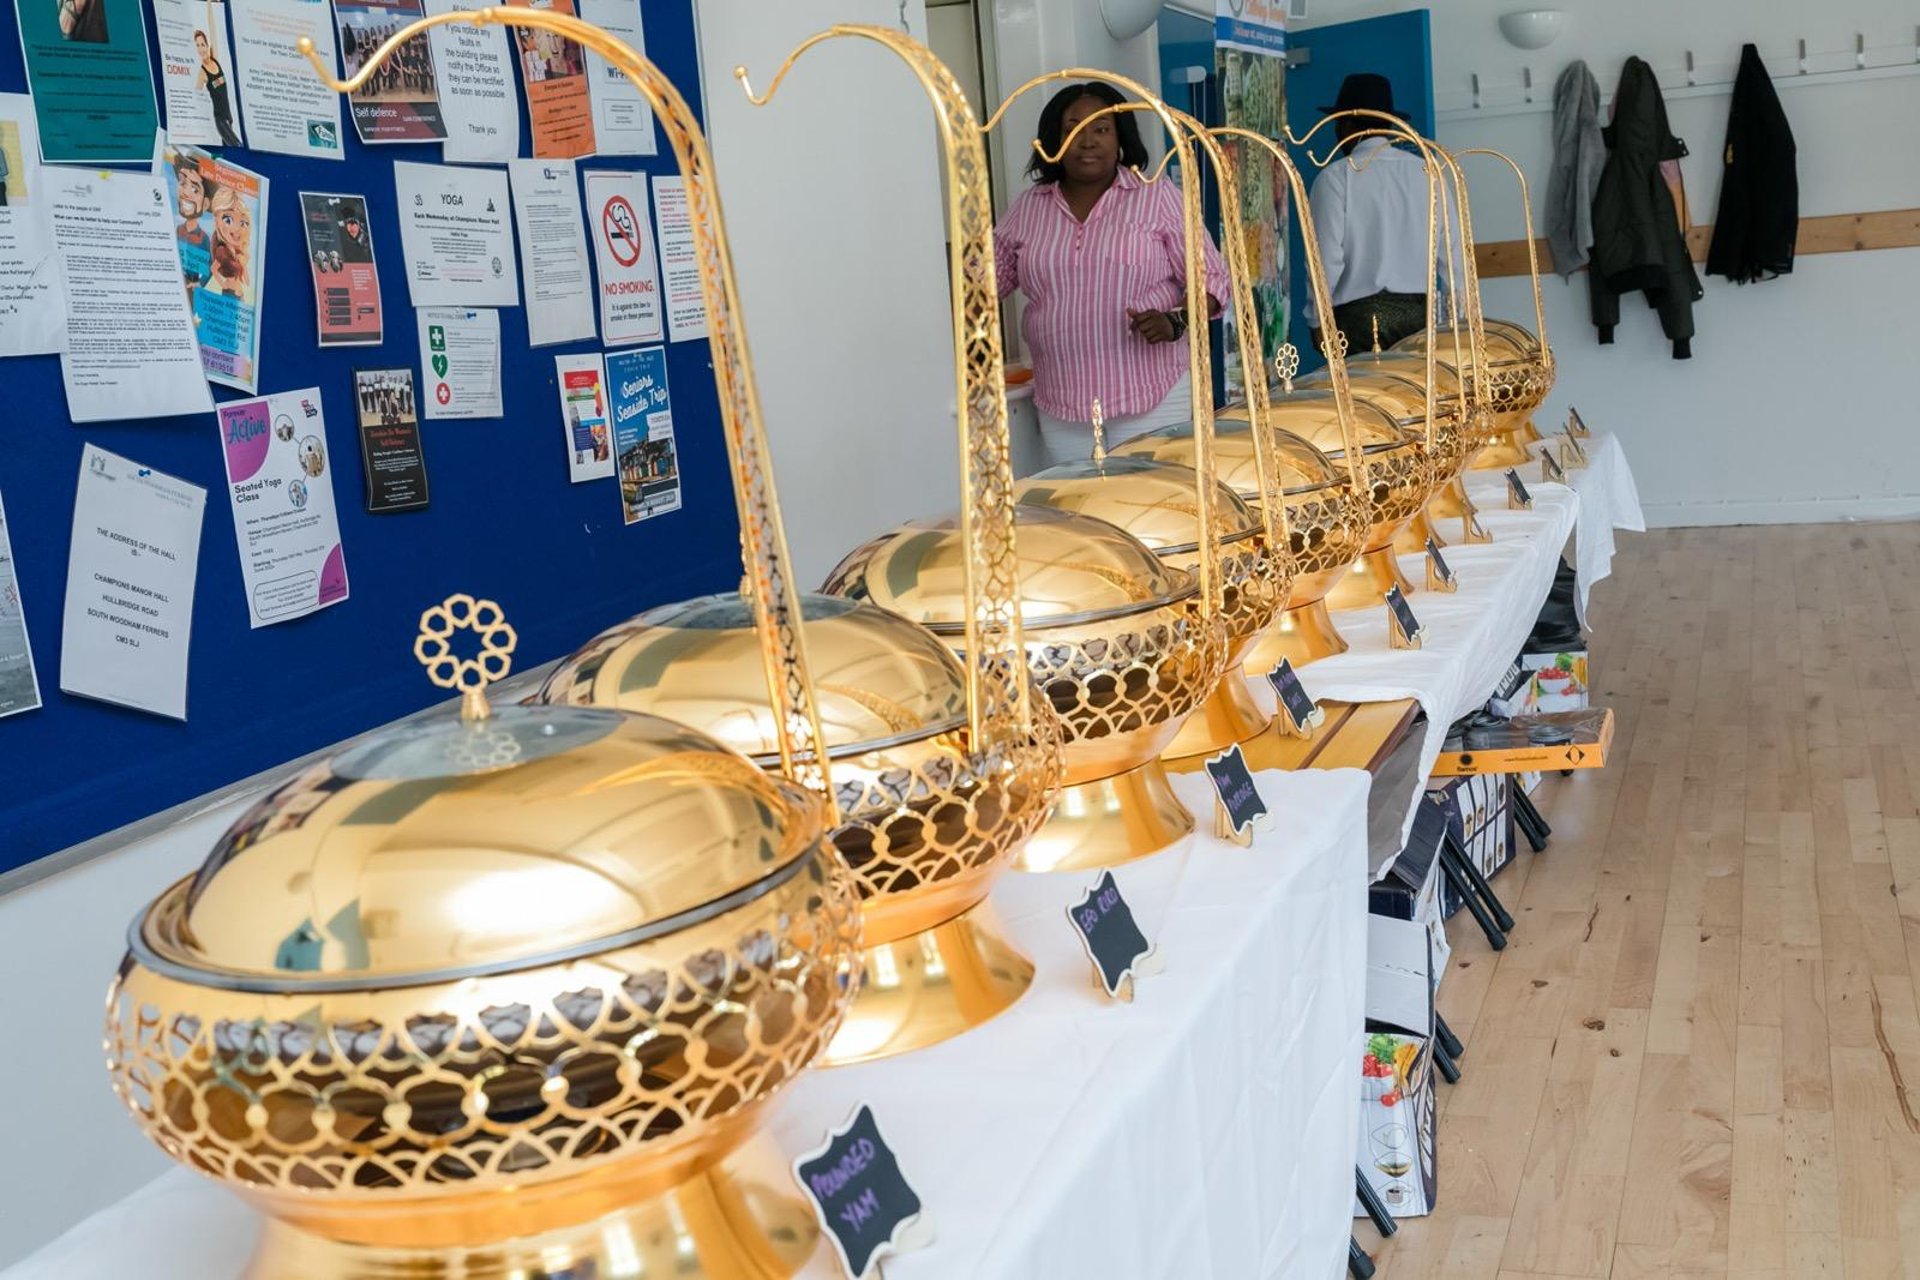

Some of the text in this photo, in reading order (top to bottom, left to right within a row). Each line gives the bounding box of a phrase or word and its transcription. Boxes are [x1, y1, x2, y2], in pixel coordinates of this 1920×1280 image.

[450, 24, 461, 33] you
[462, 26, 479, 35] notice
[480, 28, 490, 38] any
[459, 38, 474, 47] faults
[445, 48, 498, 61] the building please
[448, 61, 464, 72] notify
[465, 62, 474, 71] the
[475, 62, 492, 72] Office
[448, 73, 459, 83] they
[461, 75, 472, 83] can
[473, 75, 481, 83] be
[459, 87, 473, 95] soon
[475, 88, 481, 96] as
[355, 107, 397, 117] Self defence
[468, 124, 497, 135] Thank you
[441, 194, 464, 206] YOGA
[426, 213, 449, 221] Wednesday
[605, 282, 617, 296] NO
[622, 373, 654, 399] Seniors
[617, 386, 667, 423] Seaside Trip
[228, 416, 266, 444] Active
[234, 478, 282, 494] Seated Yoga
[236, 494, 260, 503] Class
[96, 526, 109, 537] THE
[110, 532, 139, 548] ADDRESS
[149, 545, 160, 555] THE
[160, 549, 176, 561] HALL
[94, 572, 169, 603] CHAMPIONS MANOR HALL
[102, 594, 159, 617] HULLBRIDGE ROAD
[87, 607, 169, 638] SOUTH WOODHAM FERRERS
[116, 635, 128, 644] CM3
[811, 1138, 875, 1201] POUNDED
[840, 1187, 879, 1234] YAM
